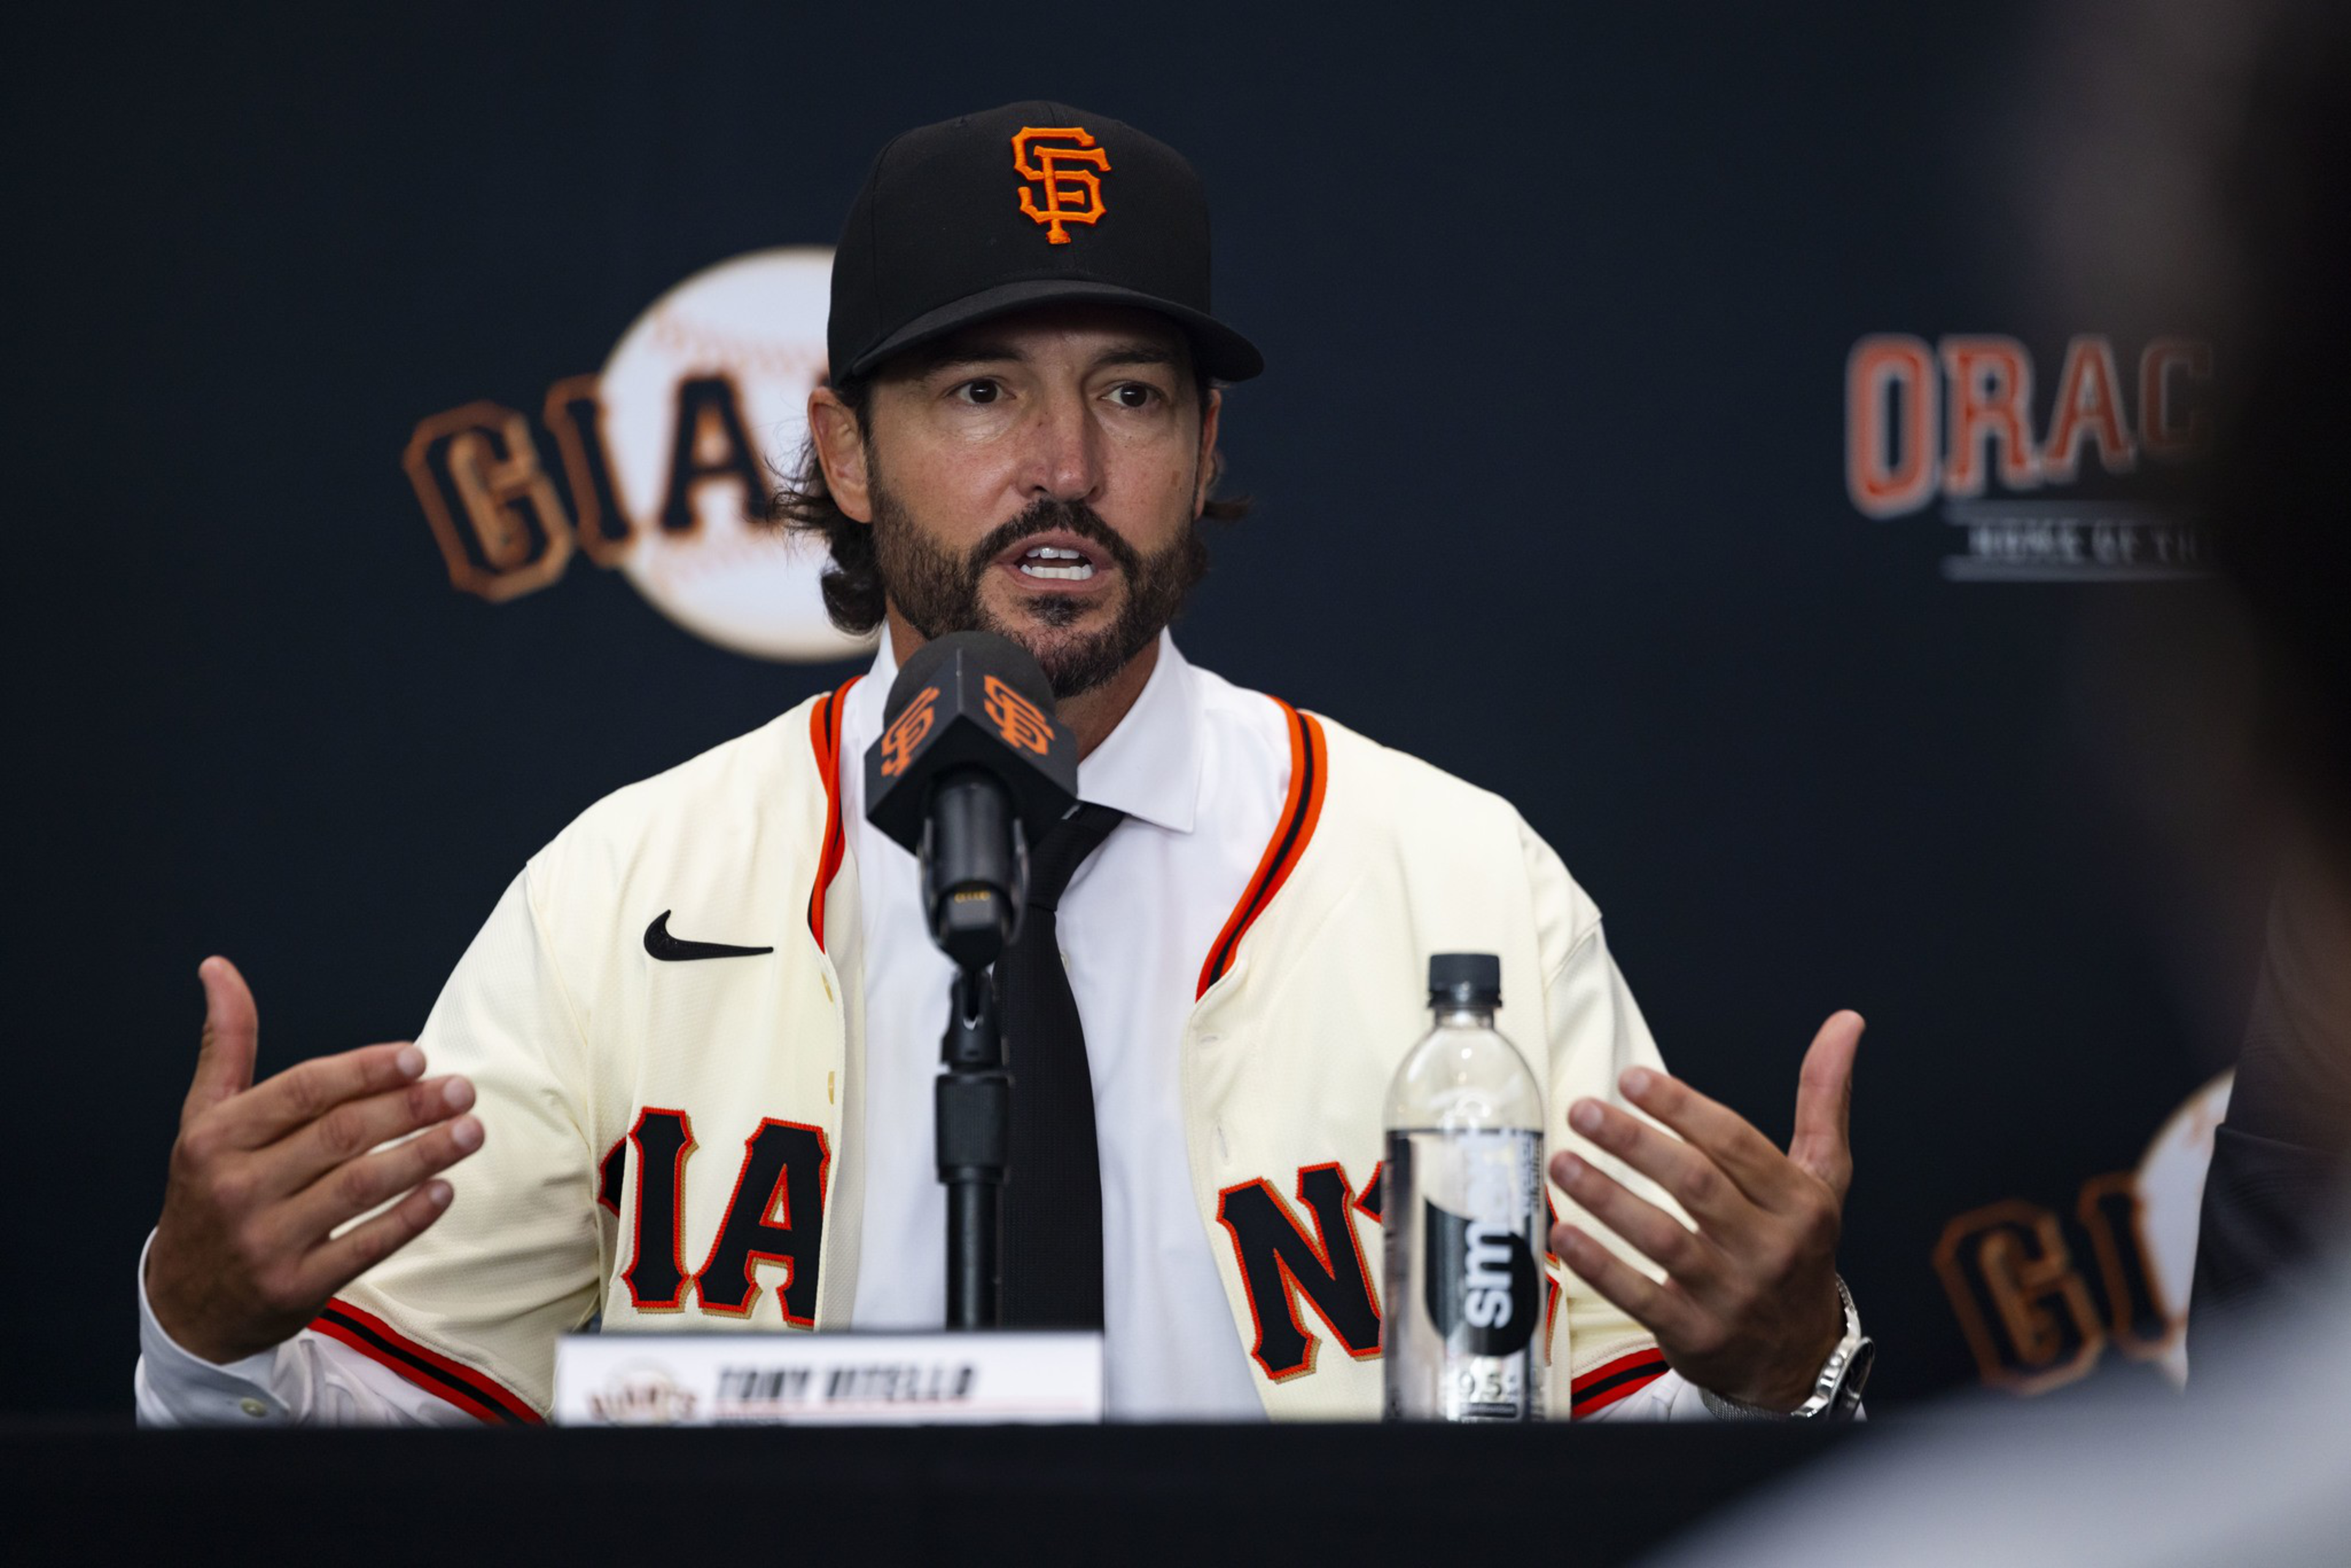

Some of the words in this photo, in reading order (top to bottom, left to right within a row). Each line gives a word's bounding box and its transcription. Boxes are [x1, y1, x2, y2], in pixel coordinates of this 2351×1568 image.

[1011, 126, 1112, 245] SF
[402, 365, 830, 604] GIA
[596, 1106, 831, 1331] IA
